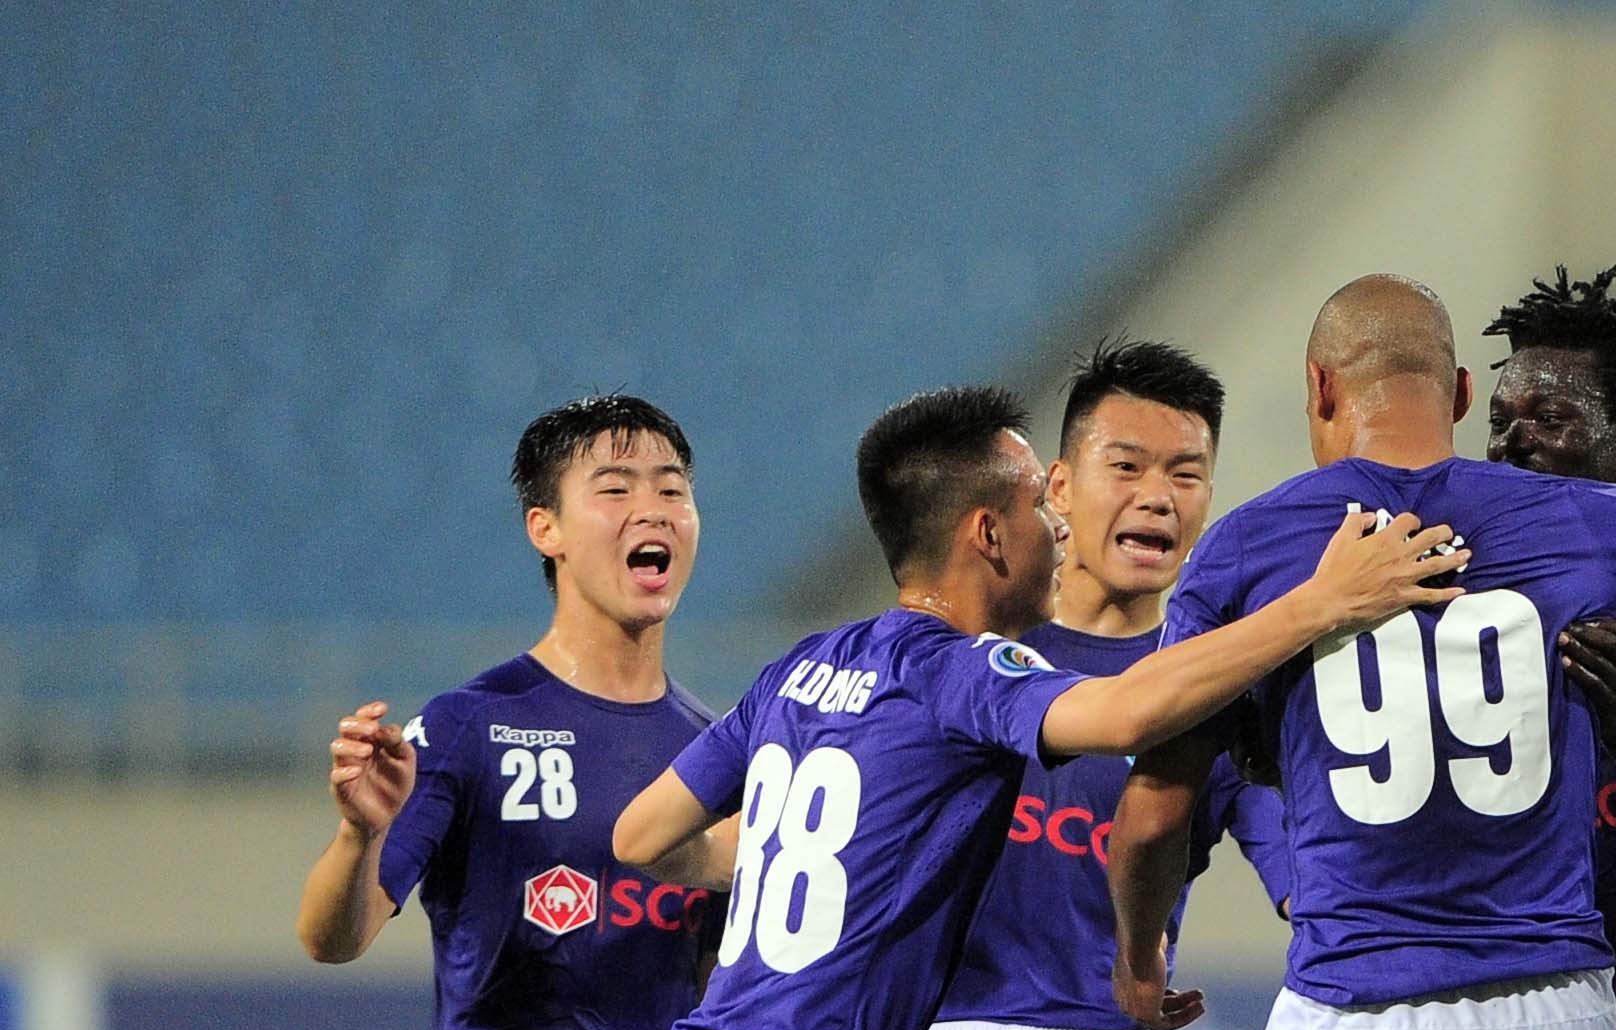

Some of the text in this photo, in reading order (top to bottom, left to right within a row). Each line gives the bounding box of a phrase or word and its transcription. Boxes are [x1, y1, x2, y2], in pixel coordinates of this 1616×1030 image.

[490, 724, 576, 747] Kappa
[1312, 588, 1552, 825] 99
[501, 748, 578, 821] 28
[718, 743, 862, 974] 88
